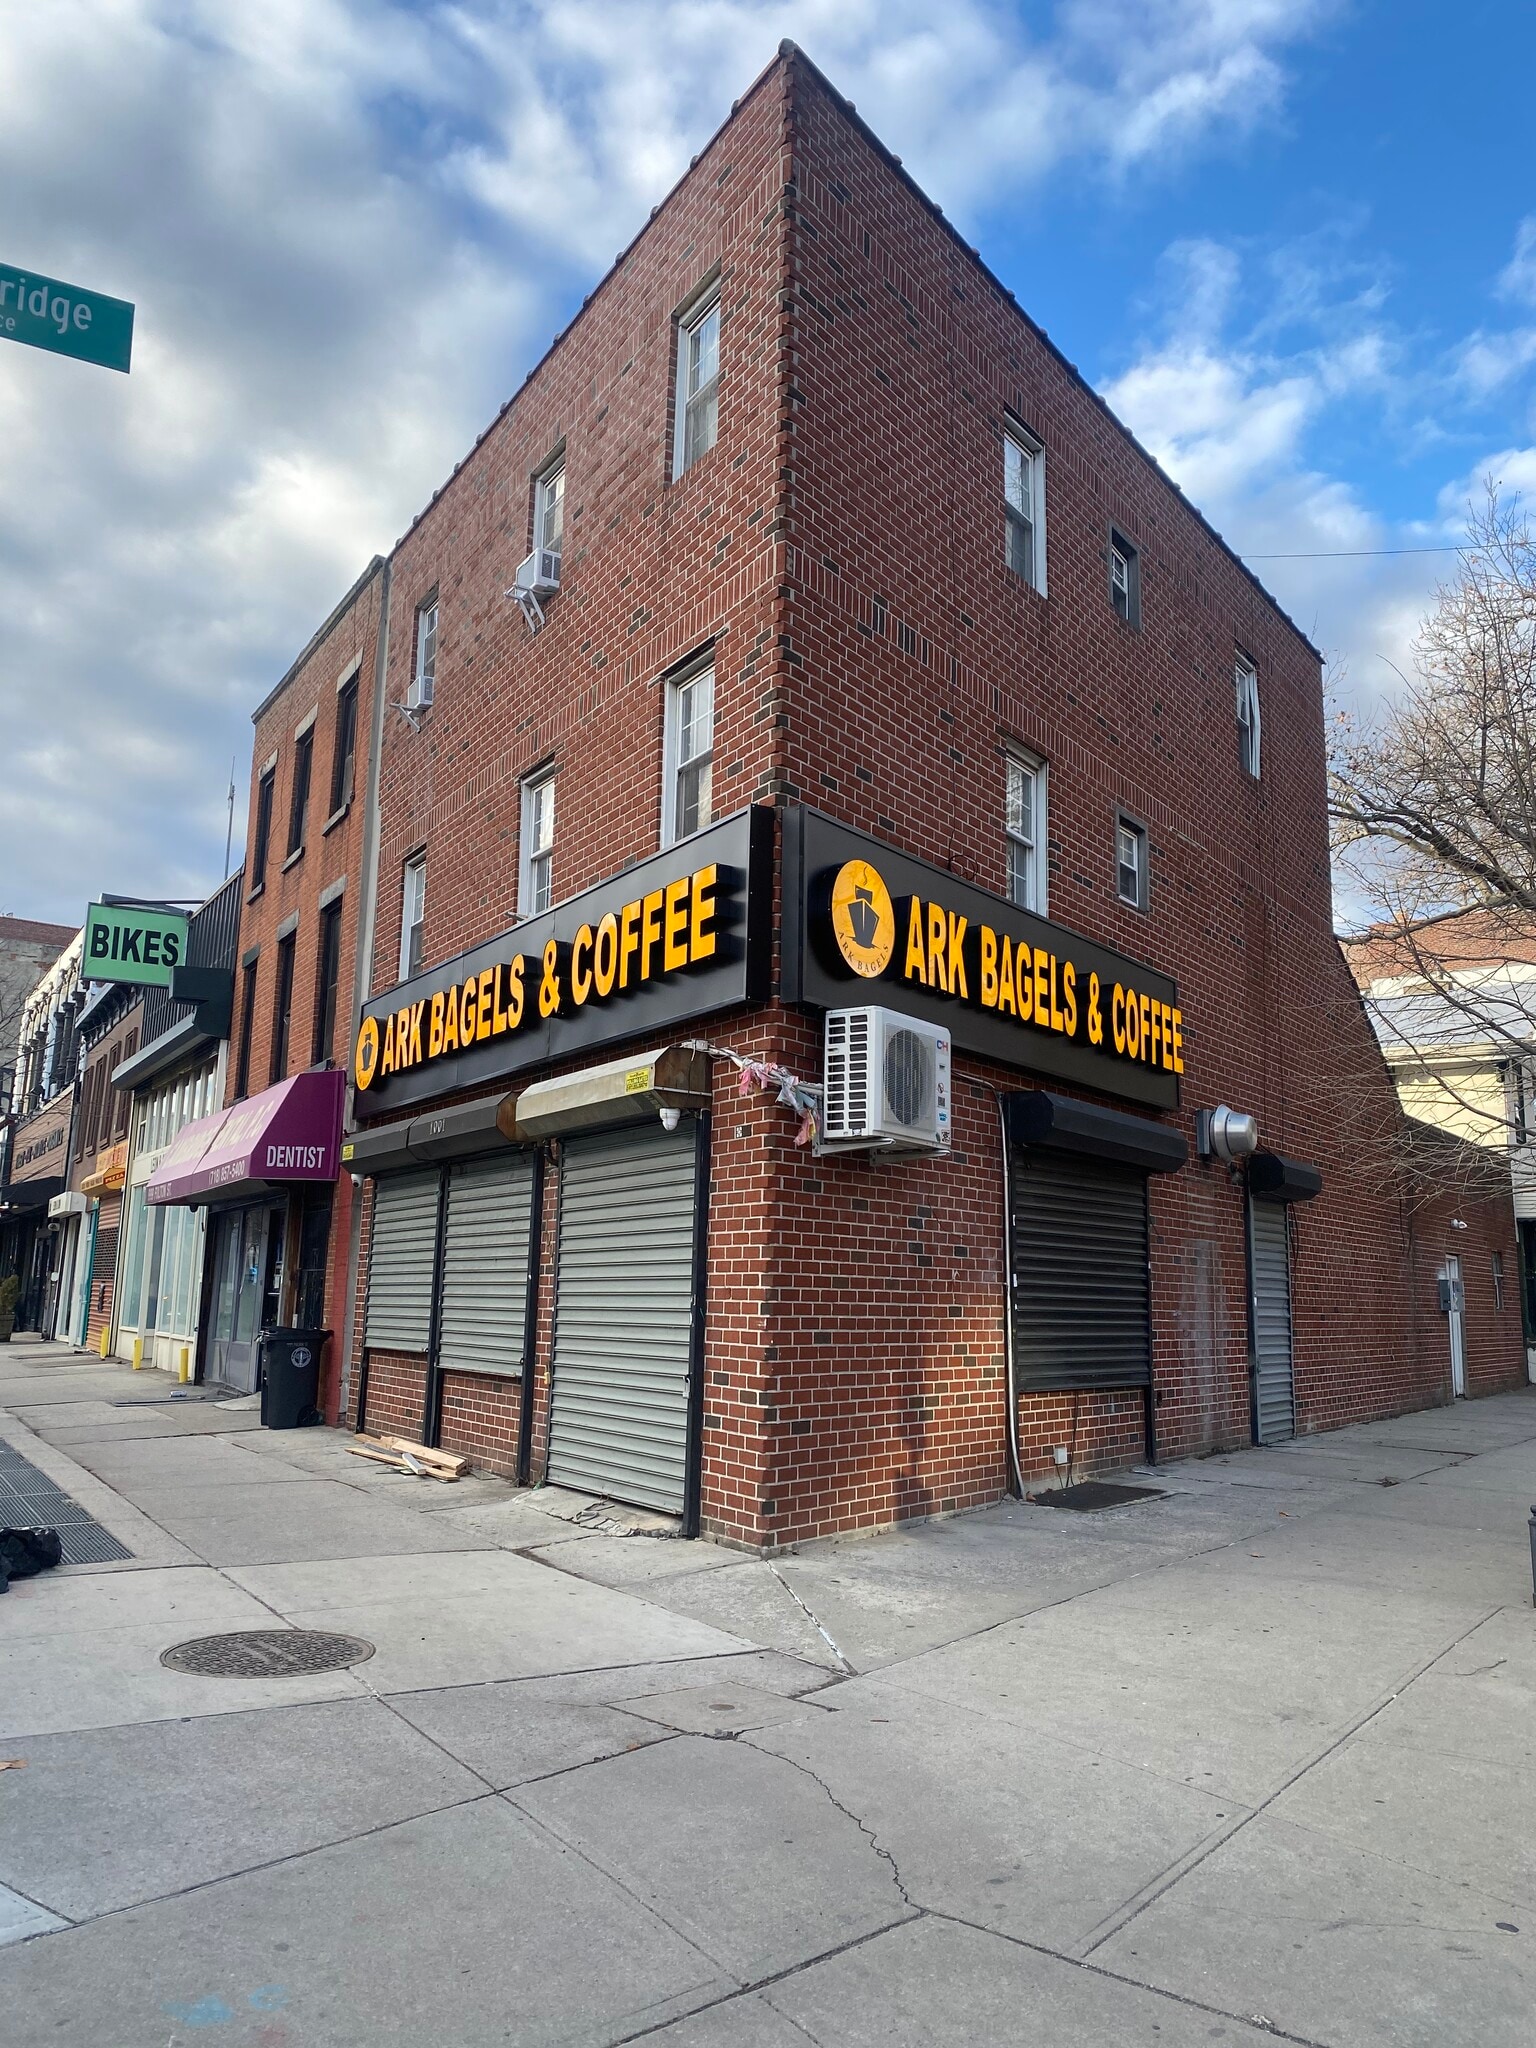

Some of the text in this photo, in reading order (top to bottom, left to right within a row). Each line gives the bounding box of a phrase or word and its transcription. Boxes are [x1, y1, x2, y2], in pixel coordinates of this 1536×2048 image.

[0, 278, 92, 334] ridge
[90, 923, 179, 967] BIKES
[838, 931, 889, 973] ARK BAGELS
[381, 863, 717, 1076] ARK BAGELS & COFFEE
[905, 895, 1184, 1074] ARK BAGELS & COFFEE
[936, 1040, 949, 1052] CH
[429, 1119, 446, 1135] 1001
[266, 1145, 325, 1168] DENTIST
[105, 1173, 124, 1183] PIZZA
